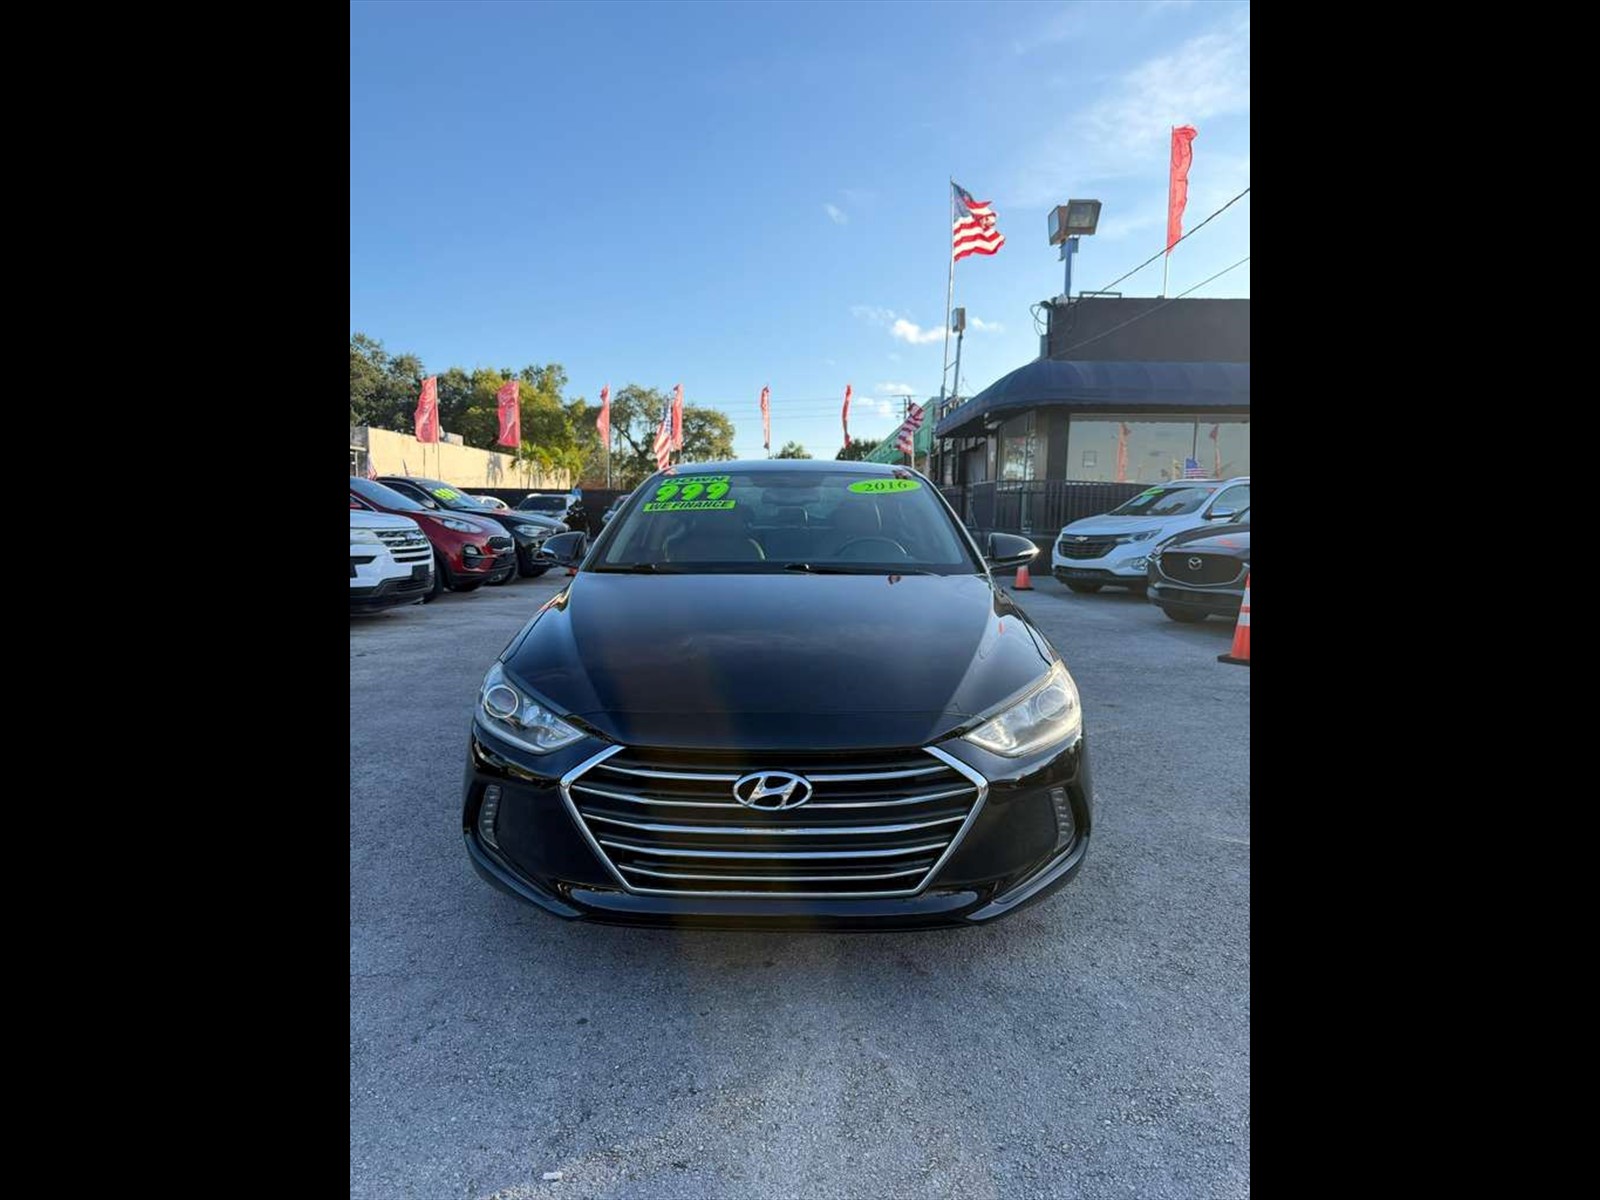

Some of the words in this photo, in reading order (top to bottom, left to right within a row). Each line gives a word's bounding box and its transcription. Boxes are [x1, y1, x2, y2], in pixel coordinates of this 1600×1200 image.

[655, 482, 730, 501] 999
[864, 481, 908, 492] 2016
[649, 501, 668, 510] WE
[671, 501, 727, 509] FINANCE
